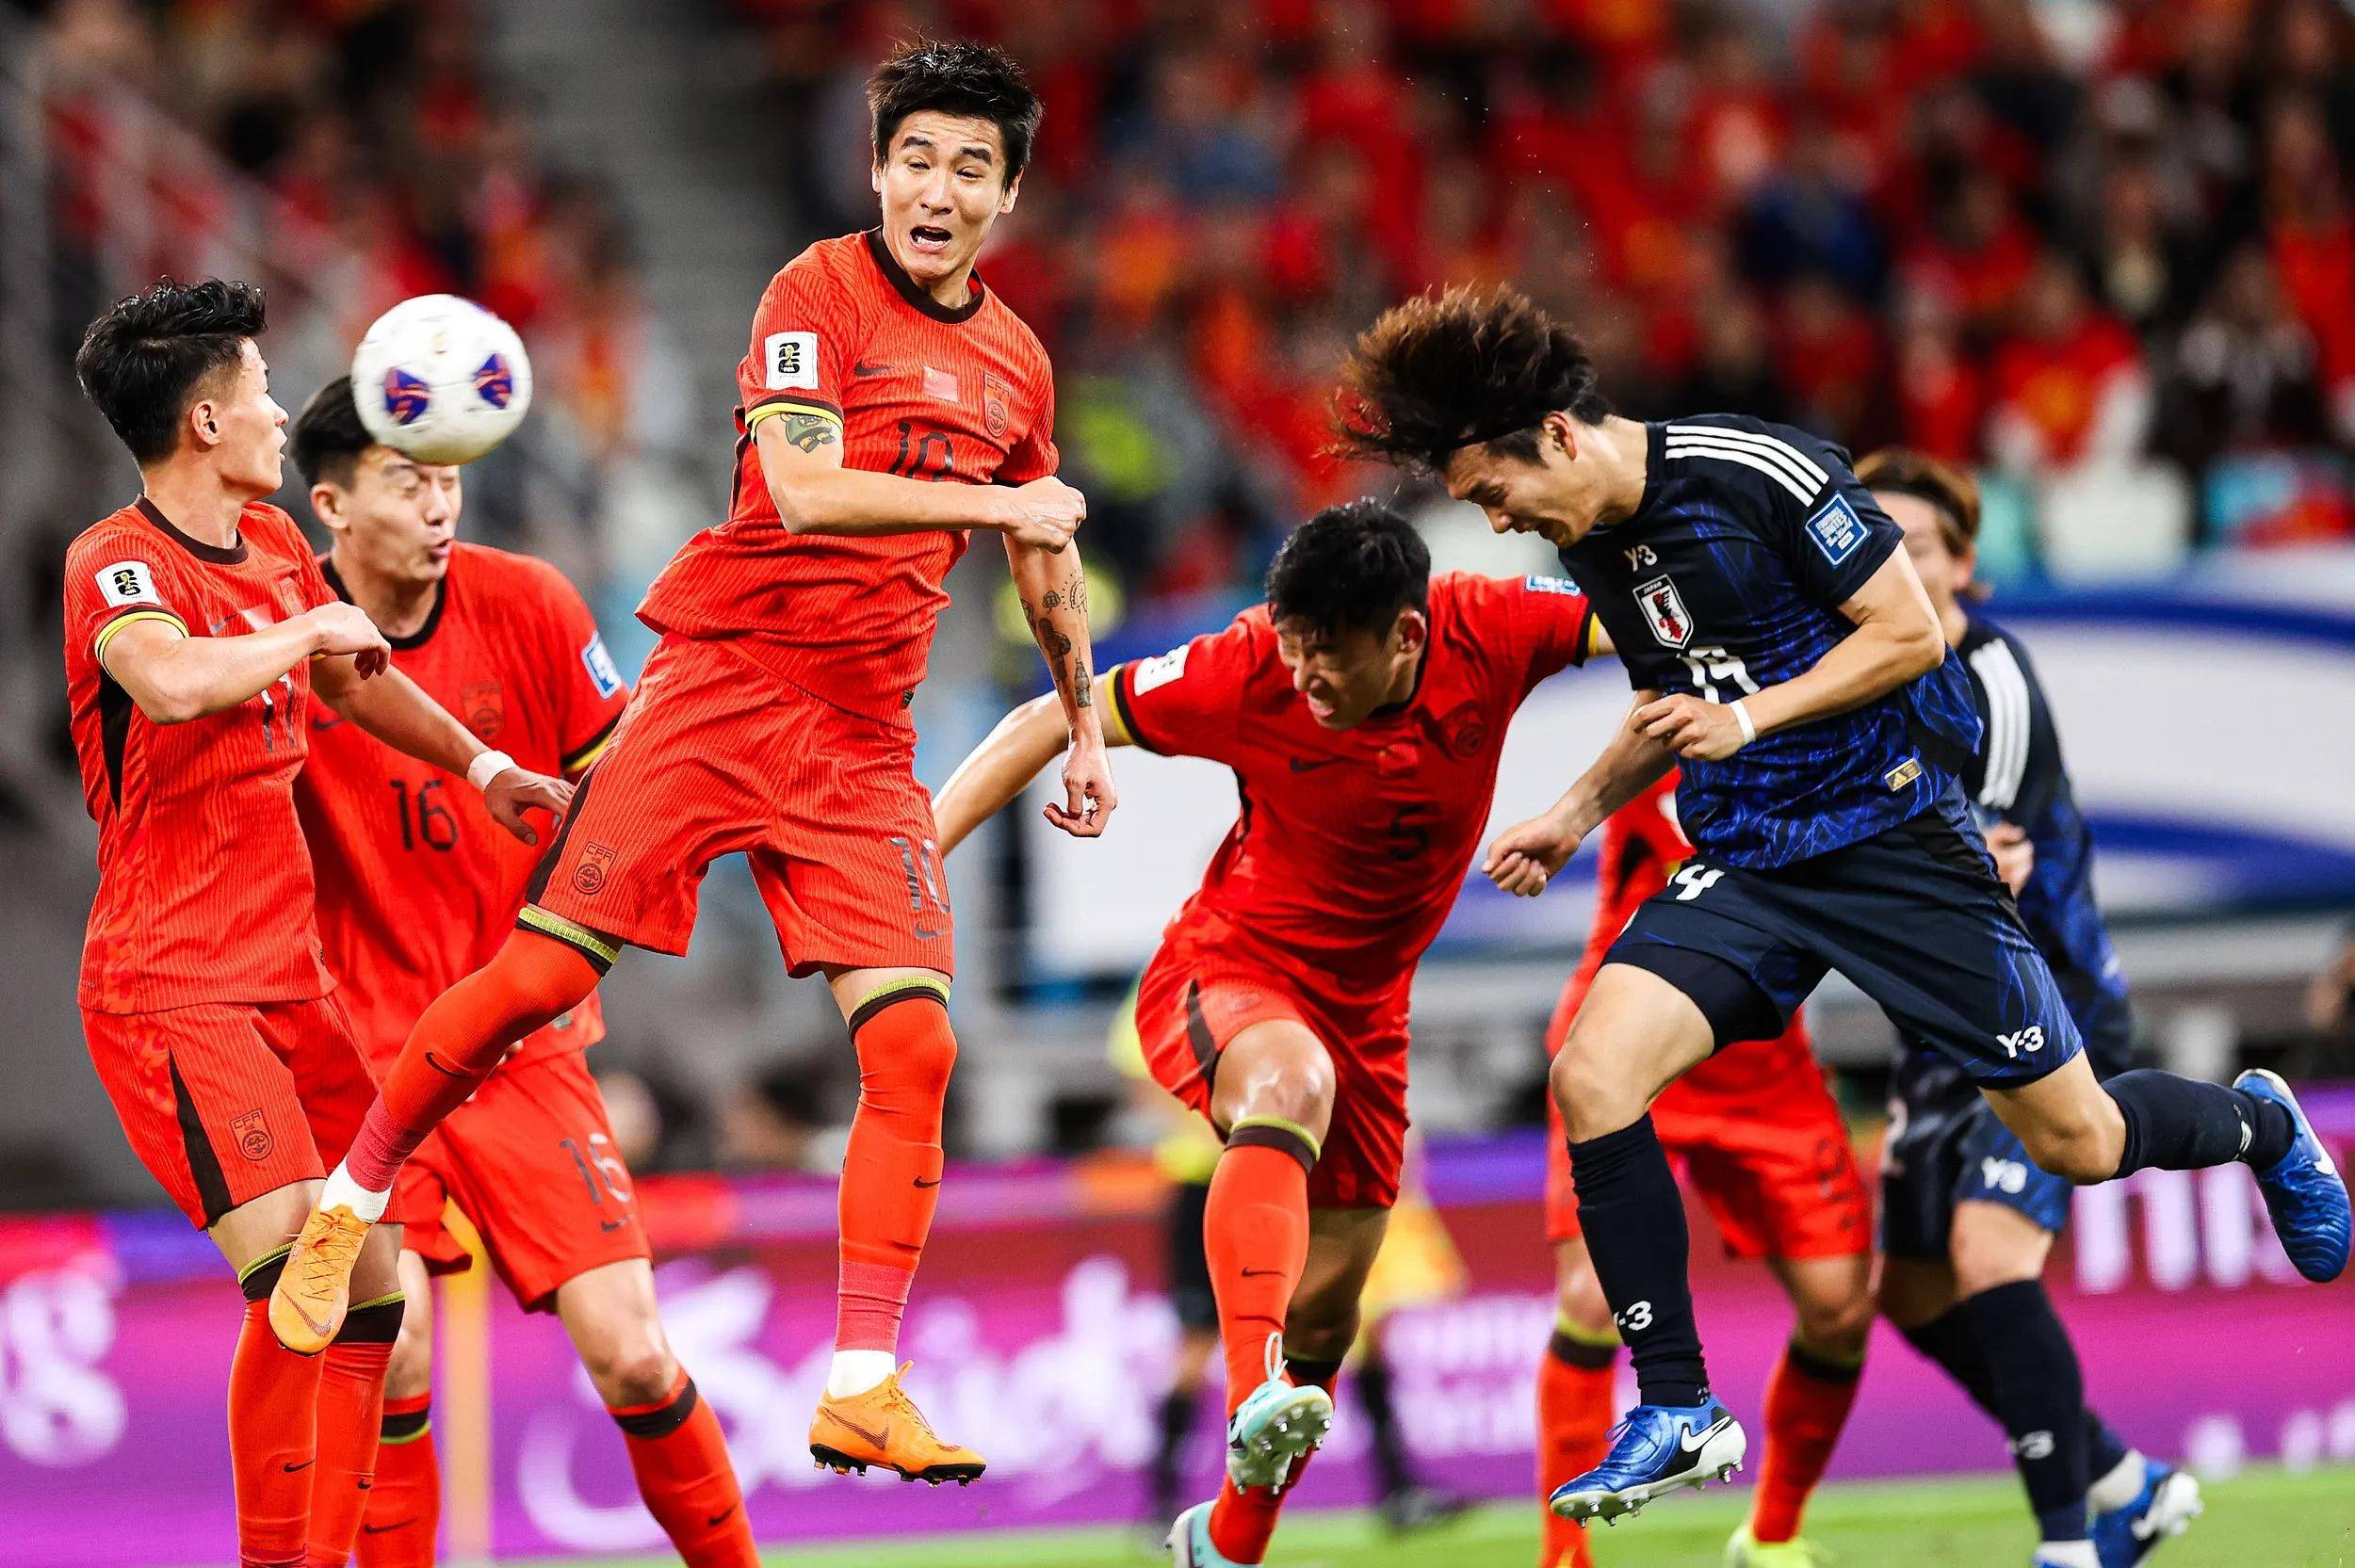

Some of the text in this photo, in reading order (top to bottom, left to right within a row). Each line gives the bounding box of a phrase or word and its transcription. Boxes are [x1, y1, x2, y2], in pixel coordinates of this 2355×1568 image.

[390, 780, 458, 851] 16
[1389, 803, 1430, 862] 5
[586, 844, 614, 863] CFA
[1996, 1025, 2045, 1059] Y-3
[233, 1111, 261, 1130] CFA
[1613, 1300, 1653, 1331] -3
